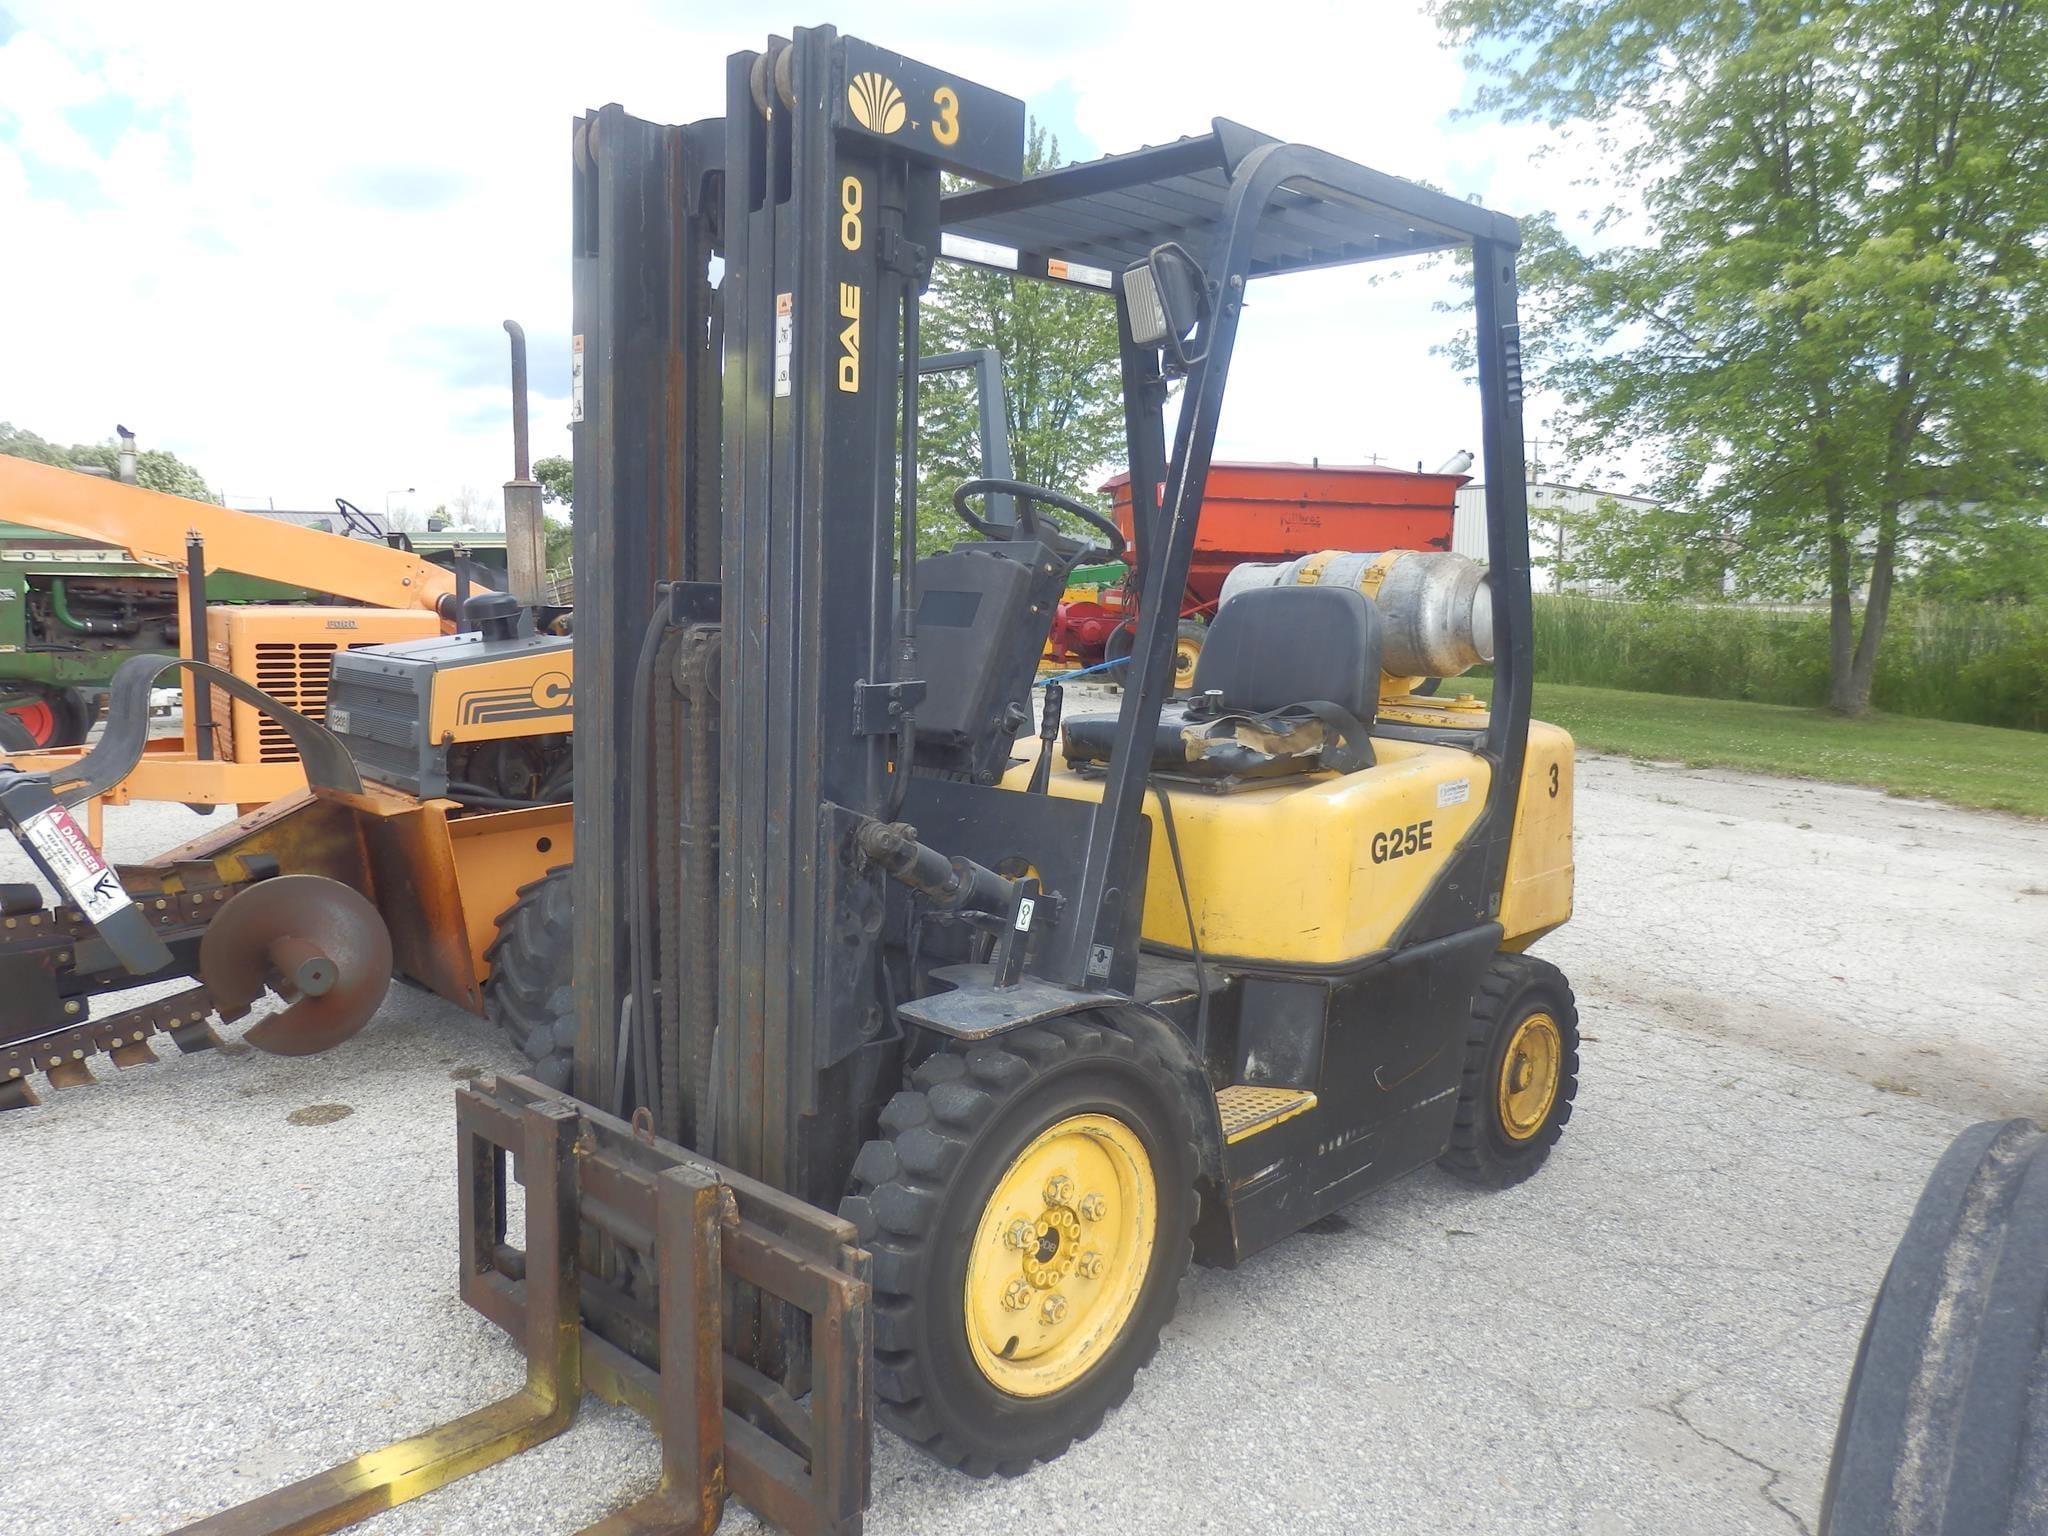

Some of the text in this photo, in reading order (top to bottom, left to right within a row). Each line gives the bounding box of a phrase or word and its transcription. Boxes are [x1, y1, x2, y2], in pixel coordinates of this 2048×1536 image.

[931, 86, 960, 146] 3
[23, 551, 134, 562] OLIVE
[1548, 762, 1560, 799] 3
[62, 825, 100, 874] DANGER
[1371, 820, 1433, 864] G25E
